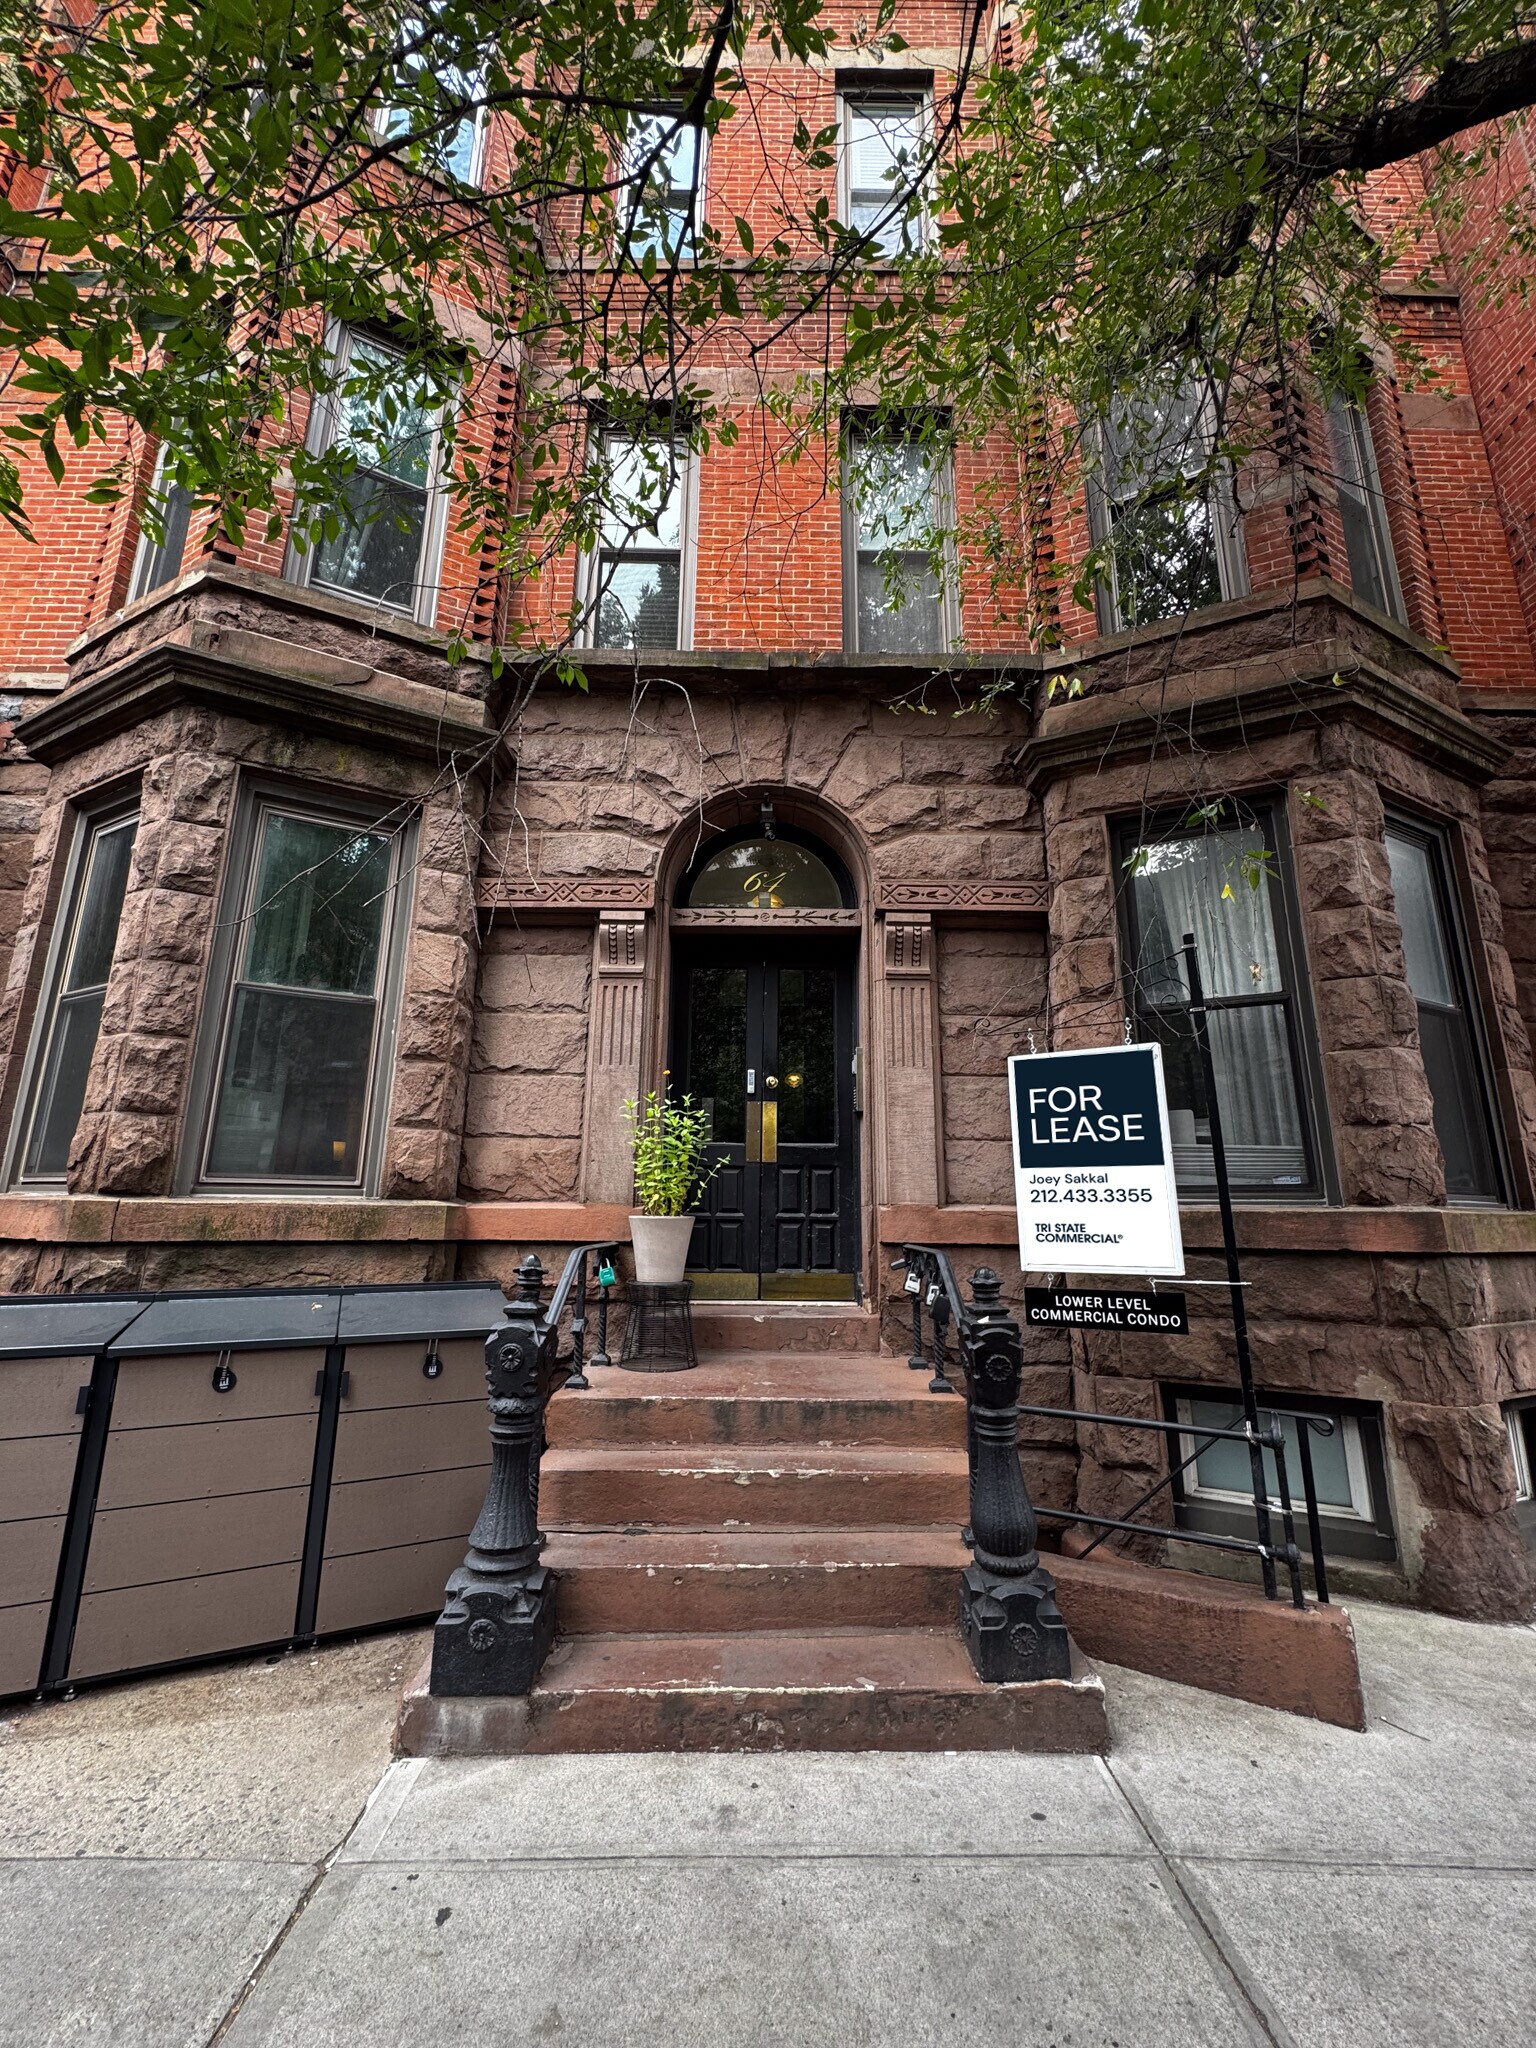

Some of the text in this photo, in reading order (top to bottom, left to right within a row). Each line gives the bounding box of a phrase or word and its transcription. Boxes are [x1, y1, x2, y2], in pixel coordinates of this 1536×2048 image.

[743, 870, 787, 893] 64
[1028, 1084, 1103, 1114] FOR
[1030, 1113, 1145, 1144] LEASE
[1029, 1172, 1109, 1187] Joey Sakkal
[1030, 1188, 1153, 1204] 212.433.3355
[1035, 1223, 1086, 1233] TRI STATE
[1055, 1295, 1152, 1311] LOWER LEVEL
[1030, 1308, 1181, 1328] COMMERCIAL CONDO
